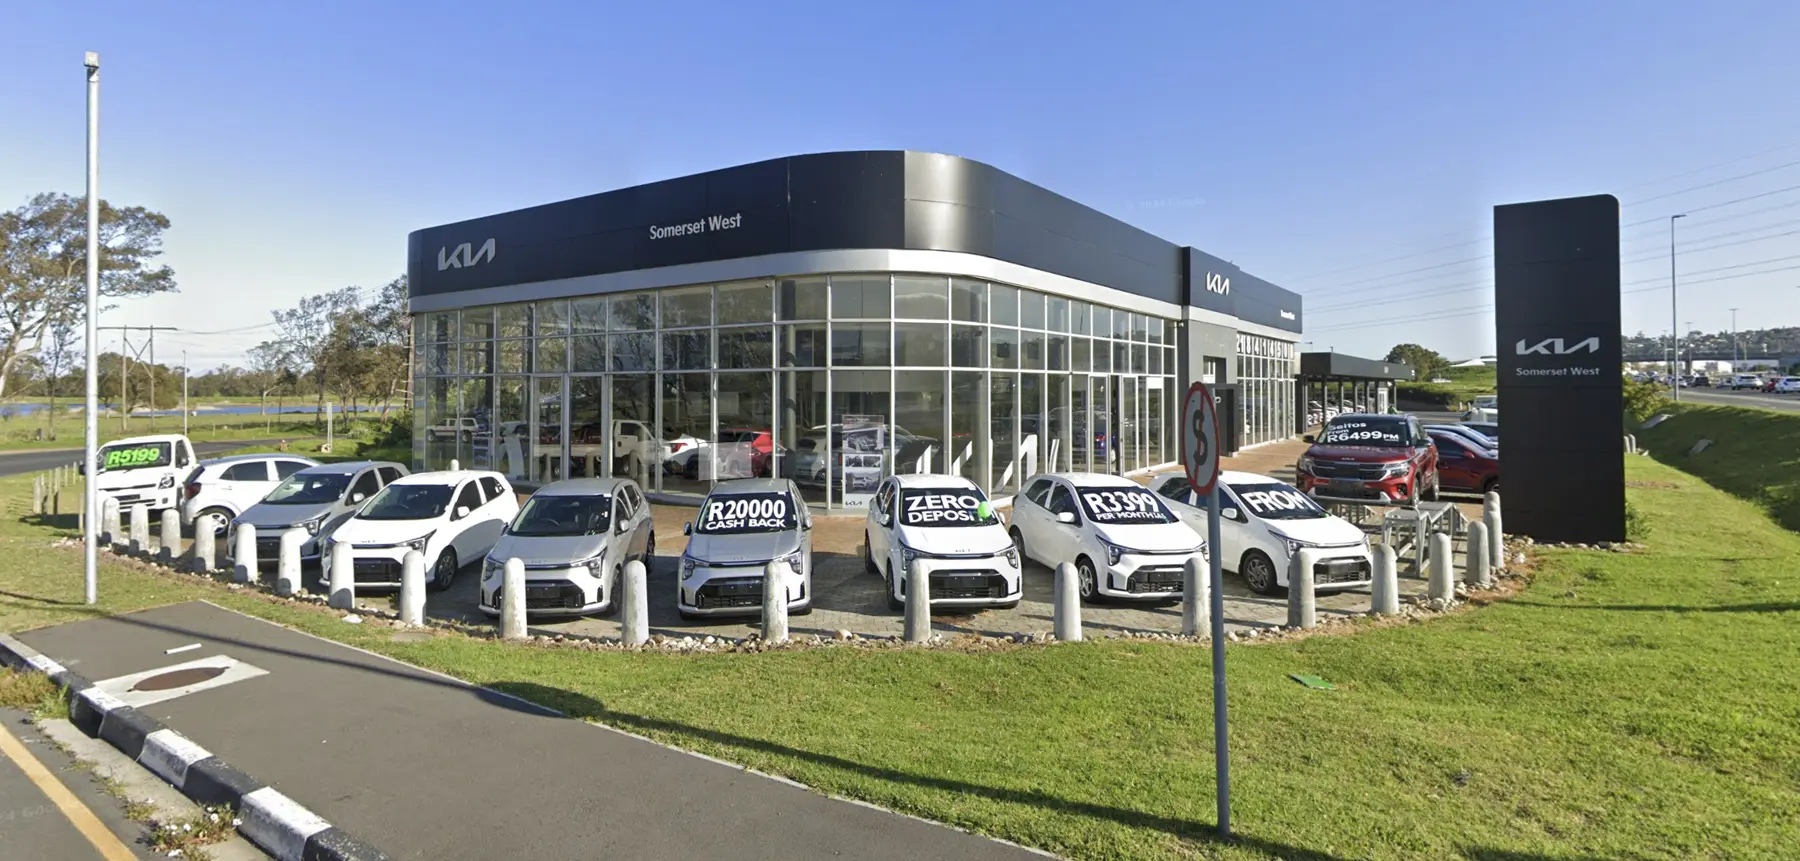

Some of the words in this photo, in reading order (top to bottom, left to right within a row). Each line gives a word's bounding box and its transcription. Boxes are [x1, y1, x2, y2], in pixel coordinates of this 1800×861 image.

[649, 218, 706, 240] Somerset
[708, 212, 742, 231] West
[437, 237, 496, 271] KIA
[1206, 271, 1230, 296] KIA
[1516, 337, 1600, 355] KIA
[1516, 366, 1568, 376] Somerset
[1570, 366, 1601, 376] West
[1327, 430, 1382, 443] R6499
[108, 447, 159, 464] R5199
[708, 499, 786, 521] R20000
[905, 494, 981, 511] ZERO
[1083, 491, 1159, 513] R3399
[1241, 490, 1316, 513] FROM
[706, 519, 745, 530] CASH
[748, 518, 786, 528] BACK
[1117, 511, 1154, 519] MONTH
